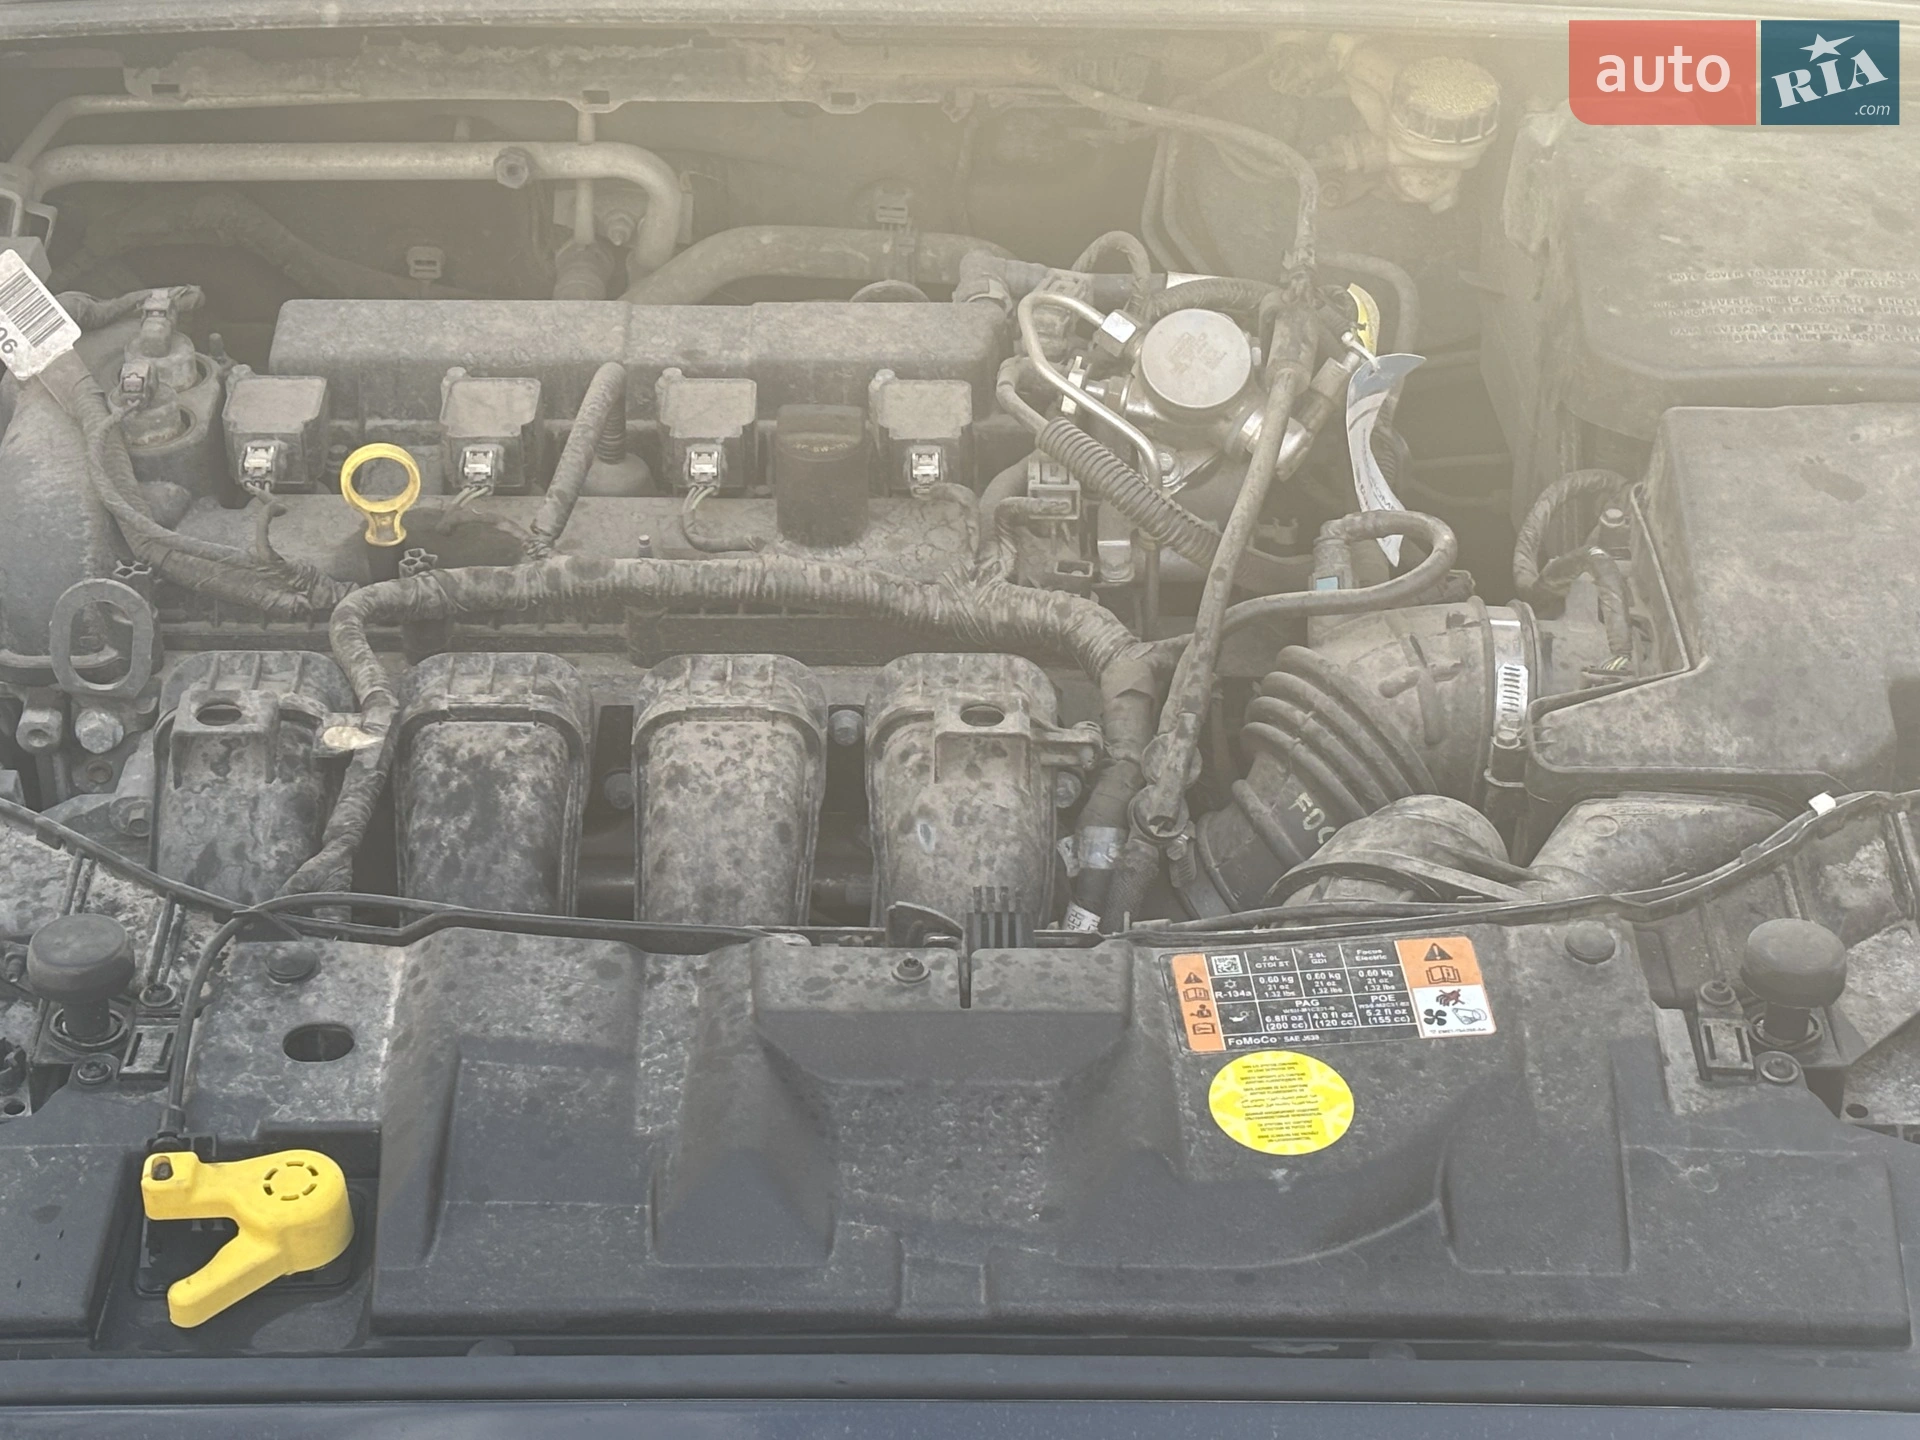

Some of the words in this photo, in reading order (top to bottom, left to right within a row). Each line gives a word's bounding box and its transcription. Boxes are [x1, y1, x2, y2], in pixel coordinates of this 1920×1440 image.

[1355, 954, 1387, 962] Electric
[1306, 972, 1326, 981] 0.60
[1328, 971, 1341, 980] kg
[1358, 969, 1379, 978] 0.60
[1380, 968, 1394, 977] kg
[1259, 976, 1279, 984] 0.60
[1281, 975, 1294, 984] kg
[1214, 990, 1252, 999] R-134a
[1370, 994, 1396, 1003] POE
[1295, 998, 1320, 1007] PAG
[1312, 1012, 1328, 1020] 4.0
[1330, 1011, 1339, 1019] fl
[1384, 1008, 1393, 1016] fl
[1315, 1019, 1338, 1028] (120
[1340, 1018, 1357, 1027] cc)
[1368, 1016, 1391, 1025] (155
[1393, 1015, 1411, 1024] cc)
[1265, 1022, 1289, 1032] (200
[1291, 1021, 1308, 1030] cc)
[1228, 1036, 1278, 1046] FoMoCo
[1283, 1035, 1301, 1043] SAE
